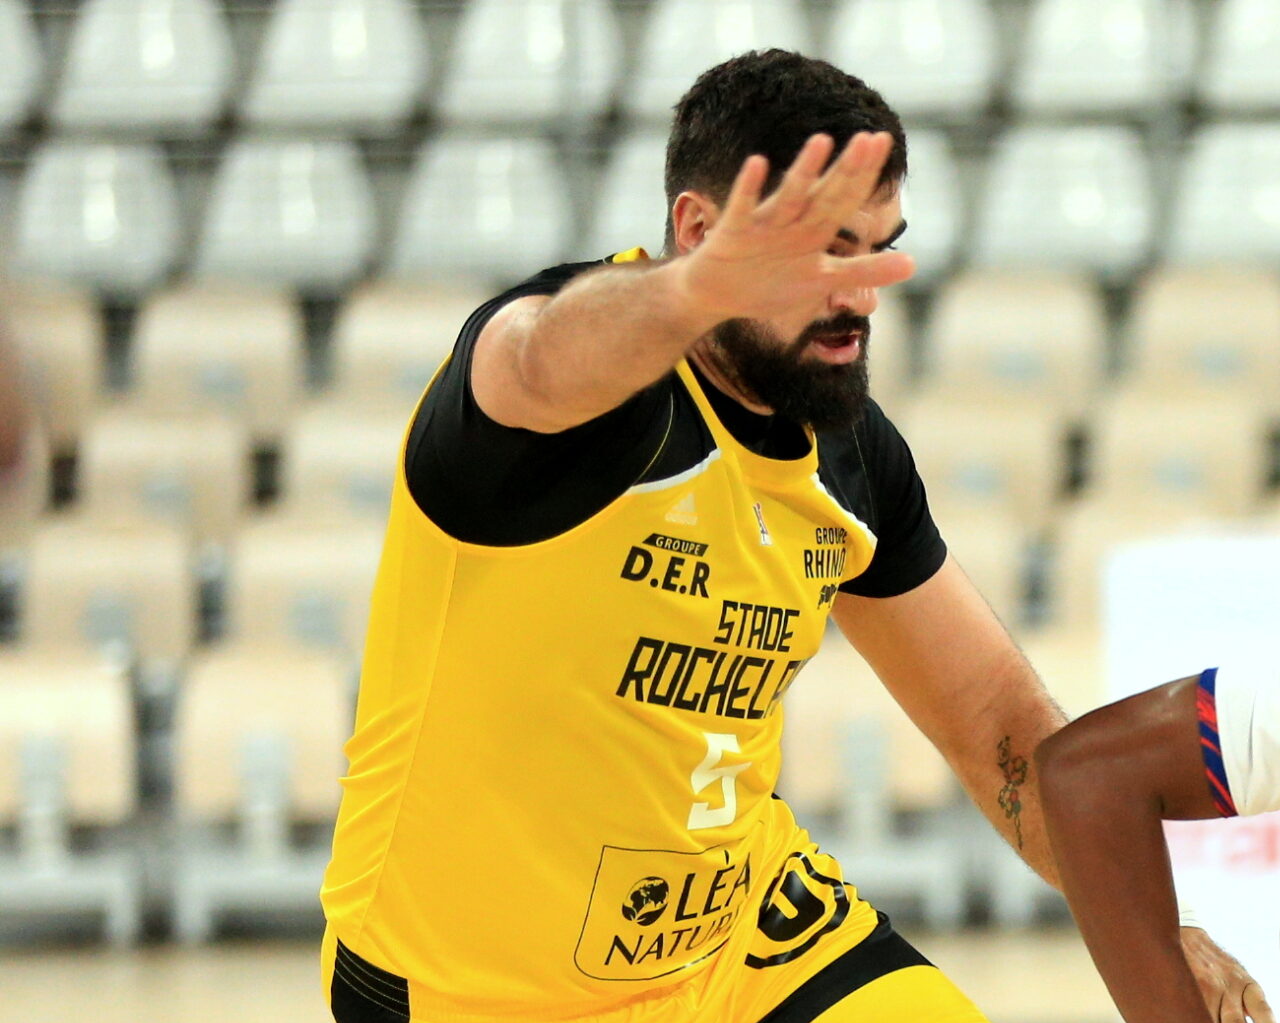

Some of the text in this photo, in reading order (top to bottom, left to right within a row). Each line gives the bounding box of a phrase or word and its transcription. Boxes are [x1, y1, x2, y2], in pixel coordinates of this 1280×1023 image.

[655, 535, 702, 556] GROUPE
[620, 546, 711, 598] D.E.R
[713, 600, 800, 652] STADE
[686, 732, 752, 830] 5
